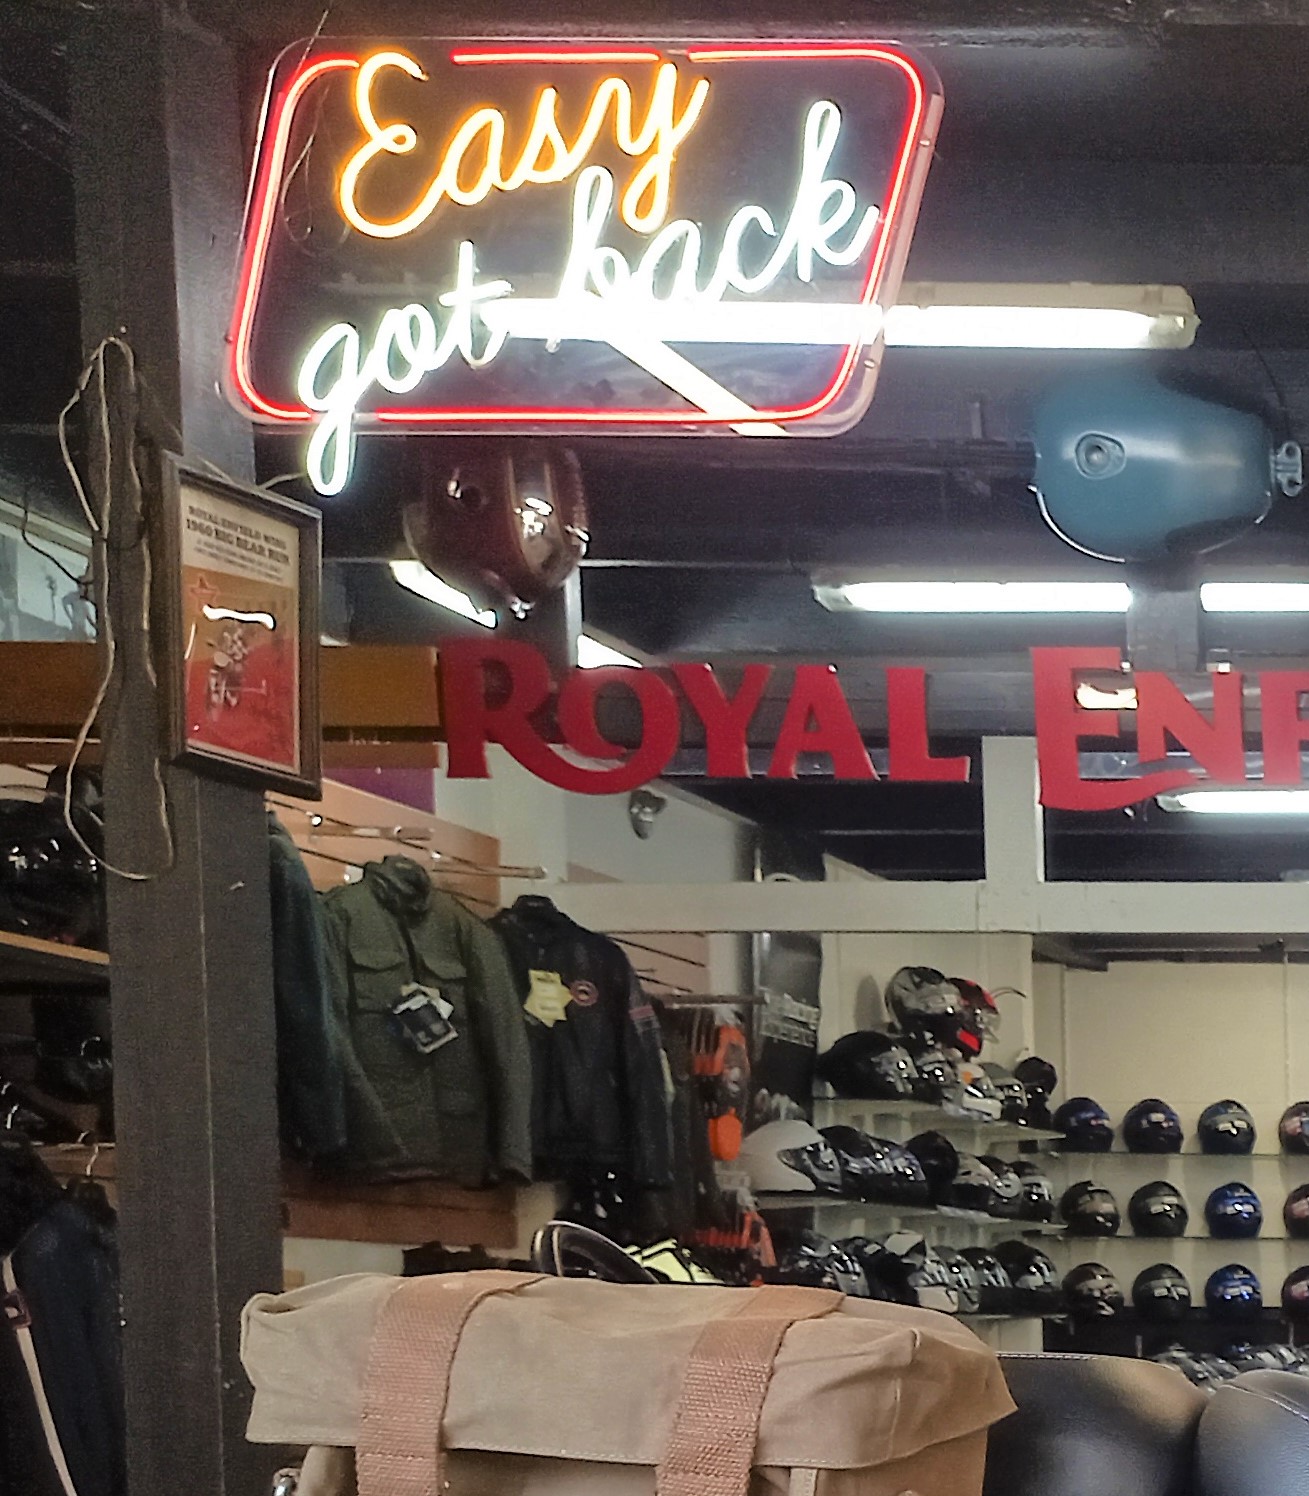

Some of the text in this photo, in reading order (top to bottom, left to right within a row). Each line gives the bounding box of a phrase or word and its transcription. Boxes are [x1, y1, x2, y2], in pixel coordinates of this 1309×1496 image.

[338, 52, 710, 238] Easy
[297, 99, 880, 496] got back
[438, 637, 971, 796] ROYAL
